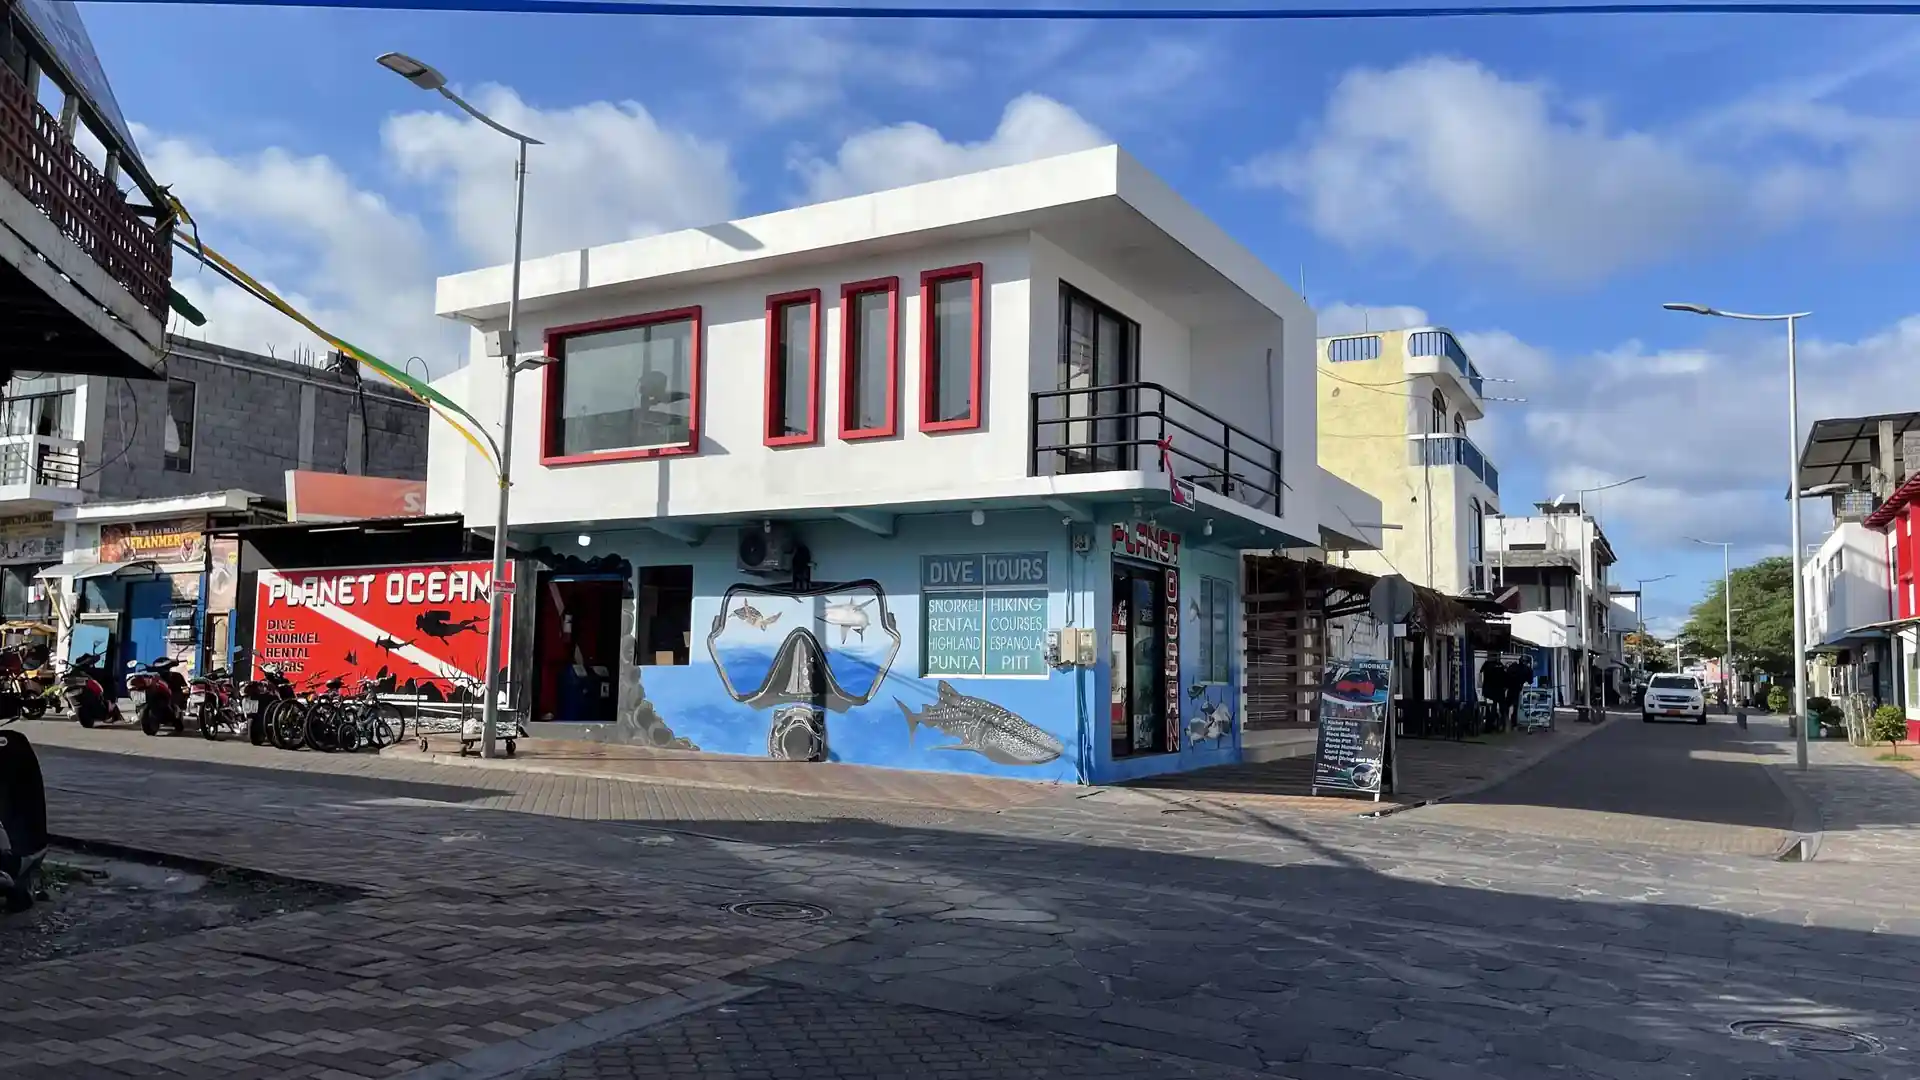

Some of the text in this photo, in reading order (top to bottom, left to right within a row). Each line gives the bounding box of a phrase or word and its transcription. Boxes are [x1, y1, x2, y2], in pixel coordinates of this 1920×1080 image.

[1112, 522, 1181, 565] PLANET
[930, 558, 1043, 583] DIVE TOURS
[270, 570, 492, 607] PLANET OCEAN
[928, 597, 1042, 613] SNORKEL HIKING
[266, 619, 296, 631] DIVE
[929, 616, 1042, 632] RENTAL COURSES
[266, 632, 321, 645] SNORKEL
[929, 636, 1041, 651] HIGHLAND ESPANOLA
[265, 647, 310, 660] RENTAL
[1166, 568, 1180, 752] OCEAN
[929, 655, 1030, 670] PUNTA PITT
